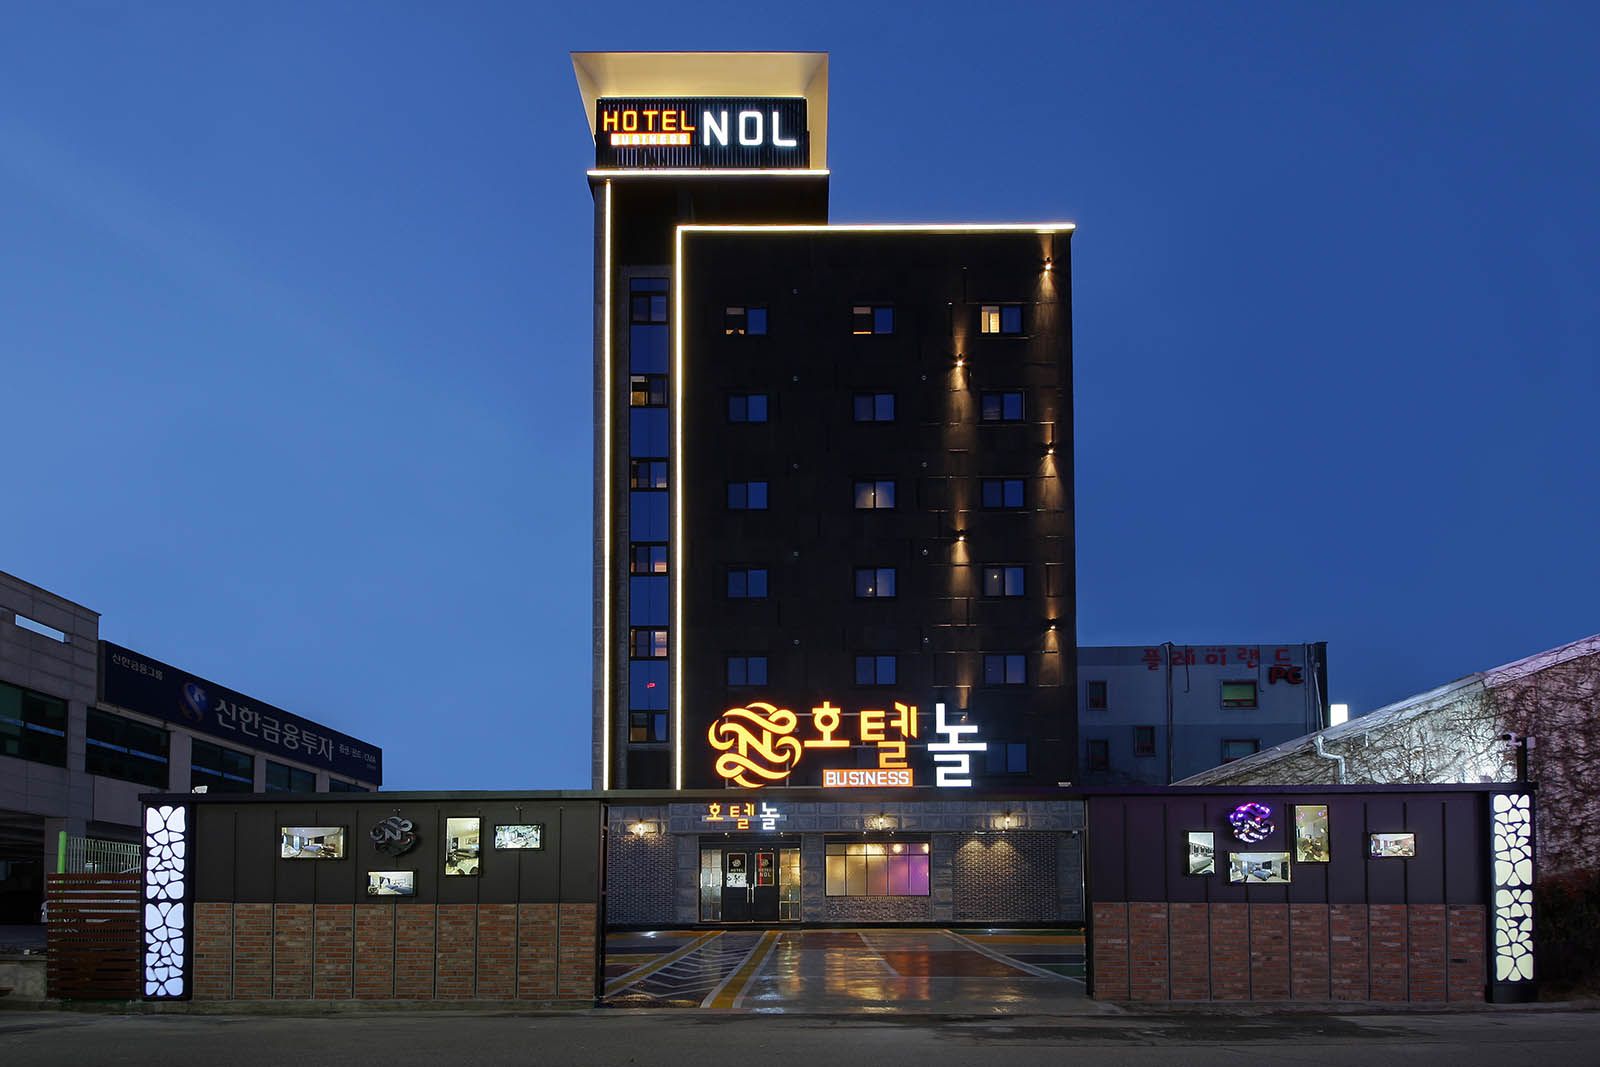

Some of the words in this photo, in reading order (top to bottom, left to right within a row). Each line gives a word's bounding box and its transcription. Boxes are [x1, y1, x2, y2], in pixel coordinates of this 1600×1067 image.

[603, 110, 695, 131] HOTEL
[703, 111, 797, 147] NOL
[1269, 666, 1304, 685] PC
[215, 697, 335, 762] 신한금융투자
[804, 701, 918, 769] 호텔
[927, 702, 988, 787] 놀
[826, 770, 910, 786] BUSINESS
[706, 802, 755, 830] 호텔
[759, 802, 781, 831] 놀
